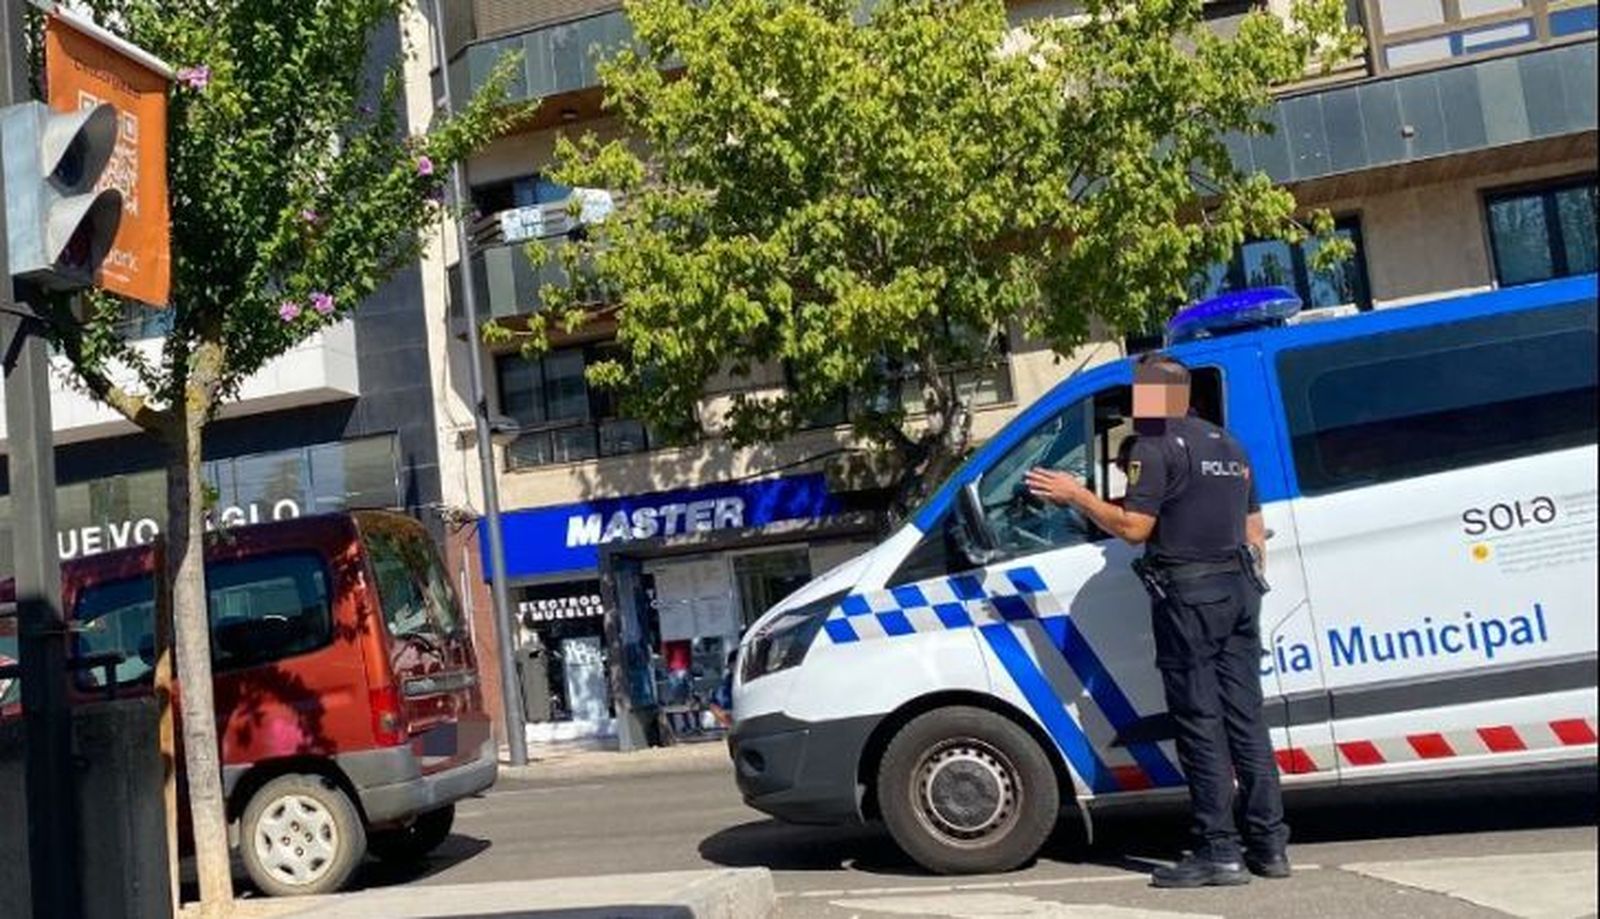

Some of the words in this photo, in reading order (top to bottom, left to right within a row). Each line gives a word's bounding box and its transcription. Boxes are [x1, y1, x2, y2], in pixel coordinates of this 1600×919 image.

[57, 518, 159, 559] UEVO
[566, 497, 746, 548] MASTER
[532, 604, 605, 621] MUEBLES
[1258, 634, 1313, 677] cía
[1327, 602, 1549, 667] Municipal
